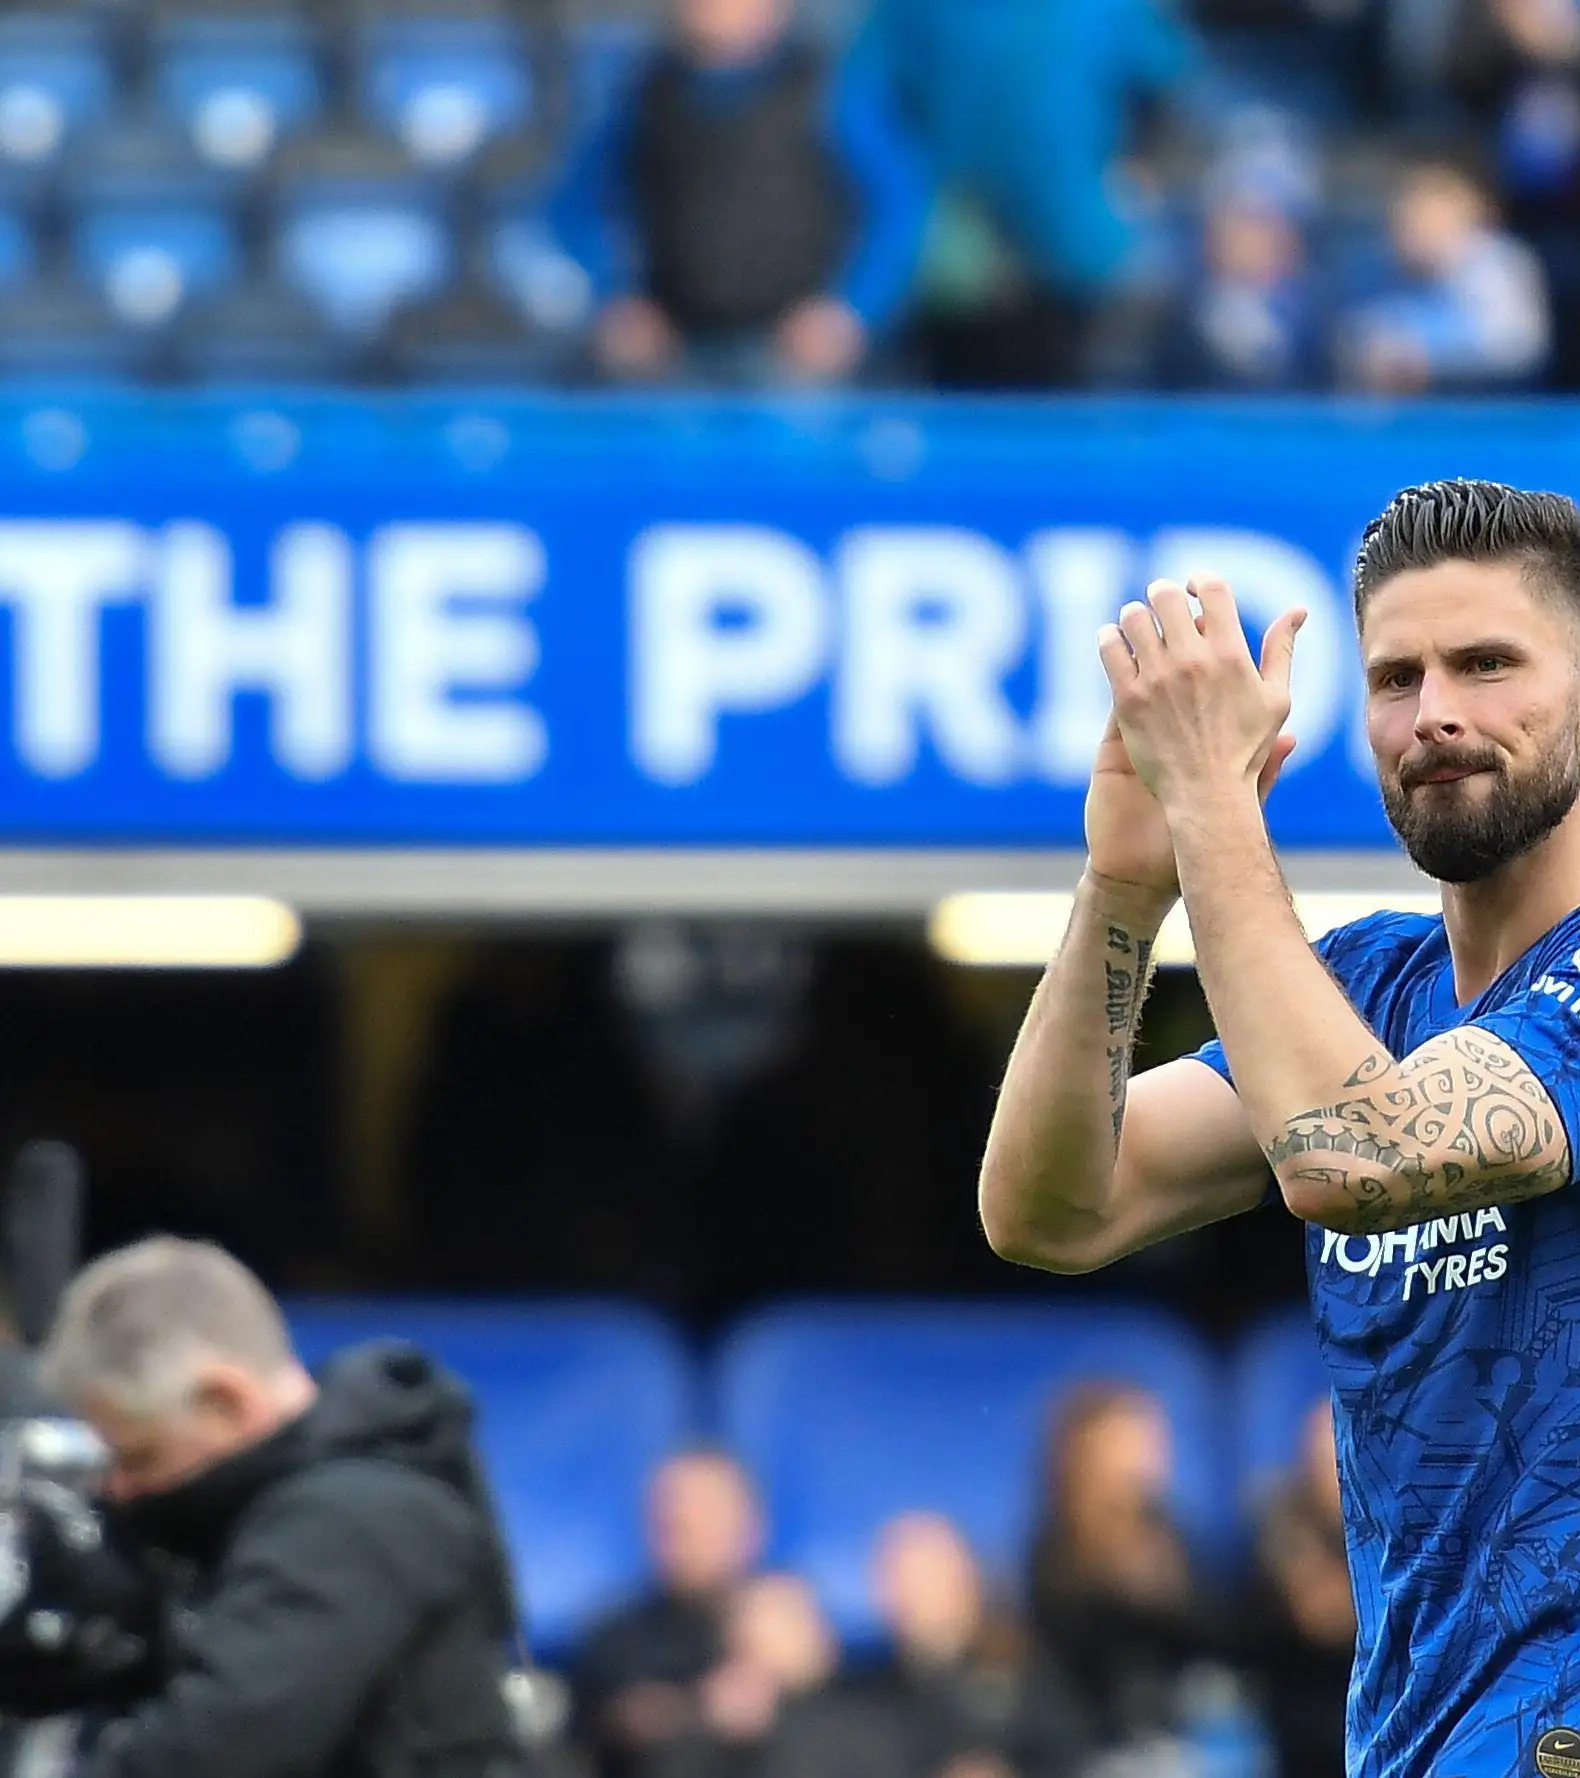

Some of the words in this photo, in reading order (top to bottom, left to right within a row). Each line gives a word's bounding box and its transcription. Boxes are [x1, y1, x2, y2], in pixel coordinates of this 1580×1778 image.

[0, 519, 544, 783] THE
[628, 522, 1378, 789] PRID
[1402, 1244, 1509, 1301] TYRES
